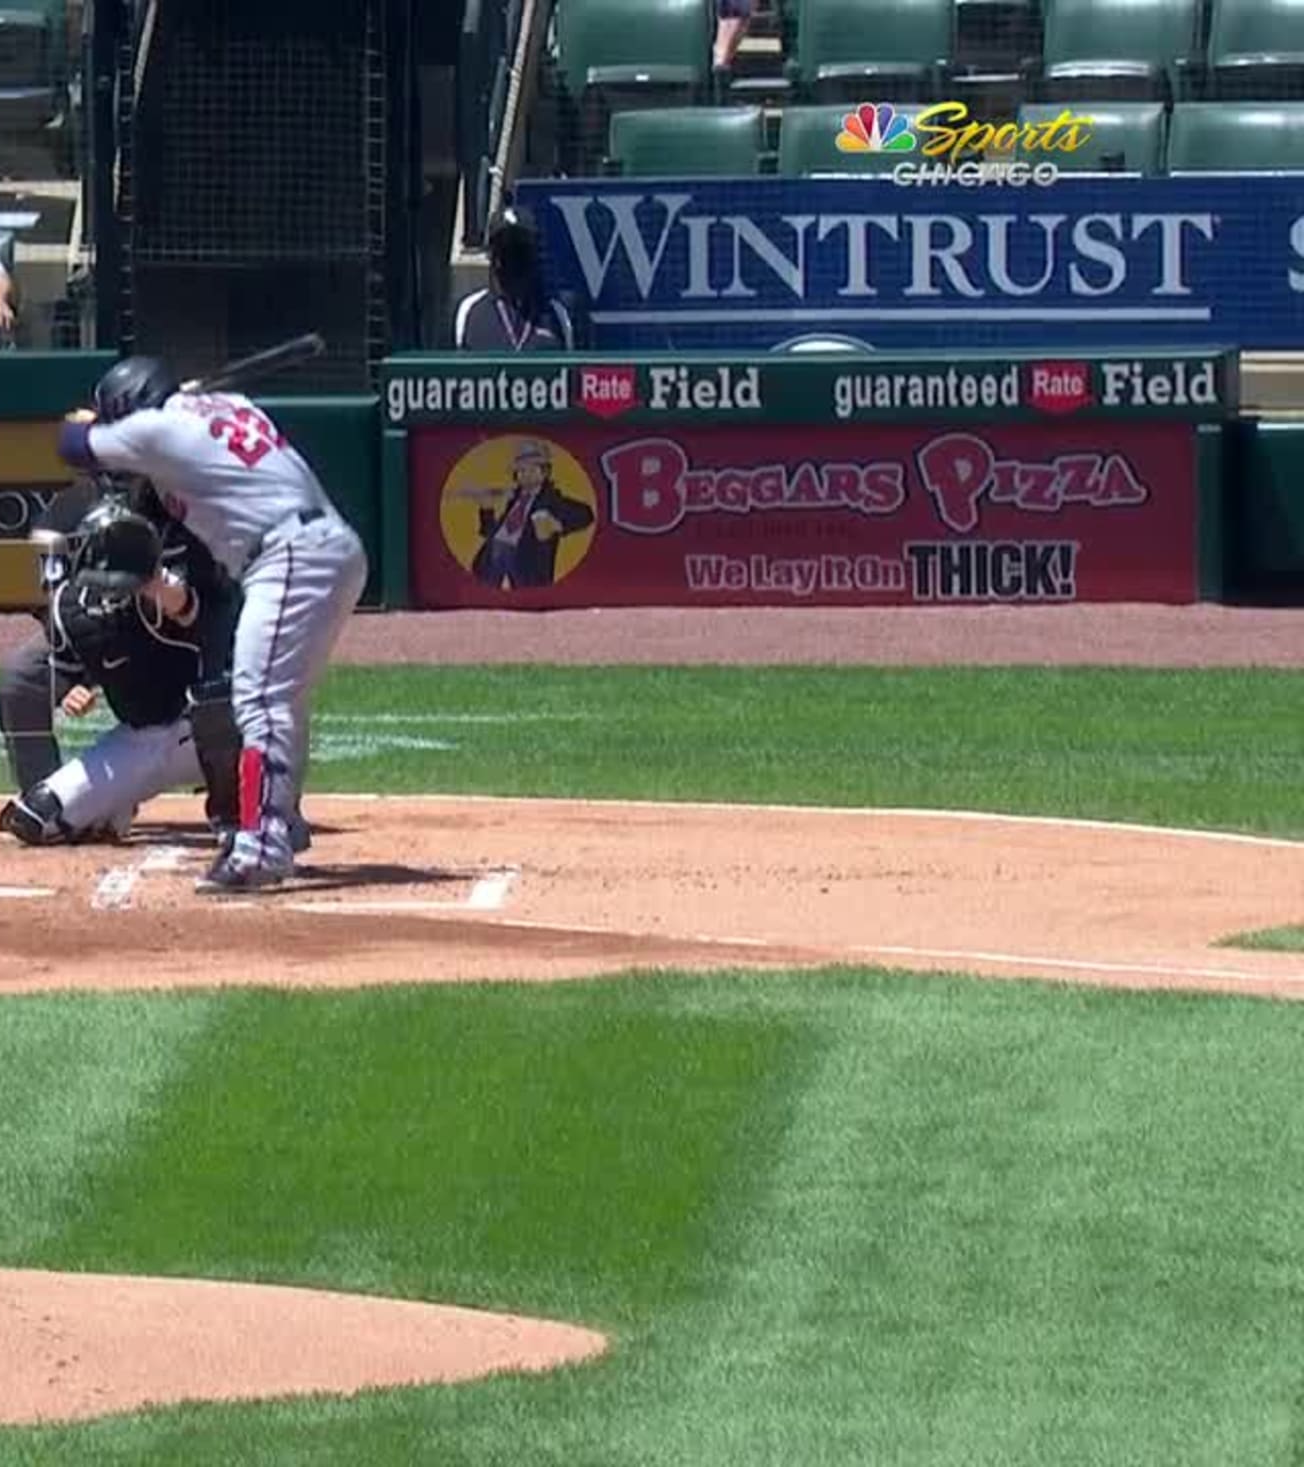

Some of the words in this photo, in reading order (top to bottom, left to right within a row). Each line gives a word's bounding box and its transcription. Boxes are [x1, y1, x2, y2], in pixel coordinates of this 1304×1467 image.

[549, 195, 1214, 300] WINTRUST
[387, 368, 567, 420] guaranteed
[581, 372, 633, 400] Rate
[648, 367, 762, 409] Field
[834, 365, 1018, 417] guaranteed
[1032, 369, 1083, 396] Rate
[1101, 362, 1217, 404] Field
[685, 554, 748, 591] We
[752, 554, 819, 595] Lay
[820, 555, 853, 590] It
[854, 555, 905, 588] On
[904, 539, 1080, 601] THICK!
